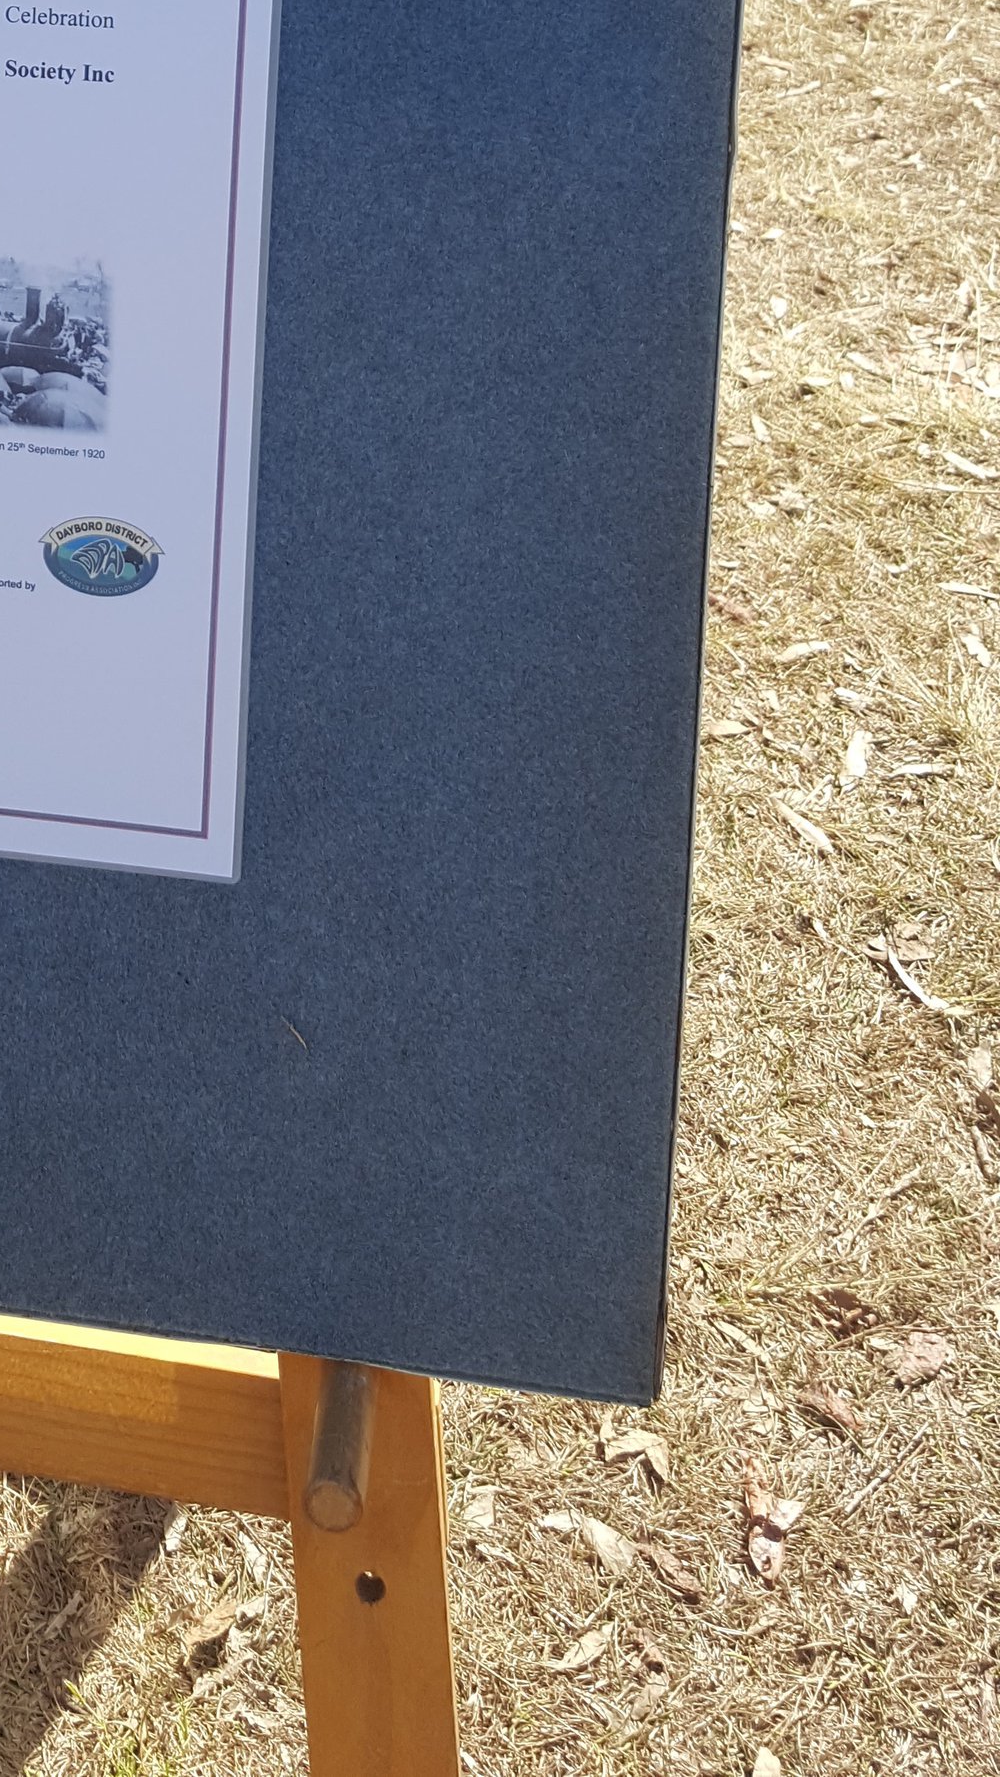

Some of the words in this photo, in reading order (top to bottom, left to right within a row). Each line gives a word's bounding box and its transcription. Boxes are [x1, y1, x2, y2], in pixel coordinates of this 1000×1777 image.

[6, 6, 114, 28] Celebration
[5, 60, 76, 84] Society
[84, 65, 114, 82] Inc
[7, 440, 26, 452] 25th
[28, 444, 79, 458] September
[82, 448, 106, 459] 1920
[56, 522, 103, 540] DAYBORO
[105, 522, 148, 548] DISTRICT
[25, 581, 35, 592] by
